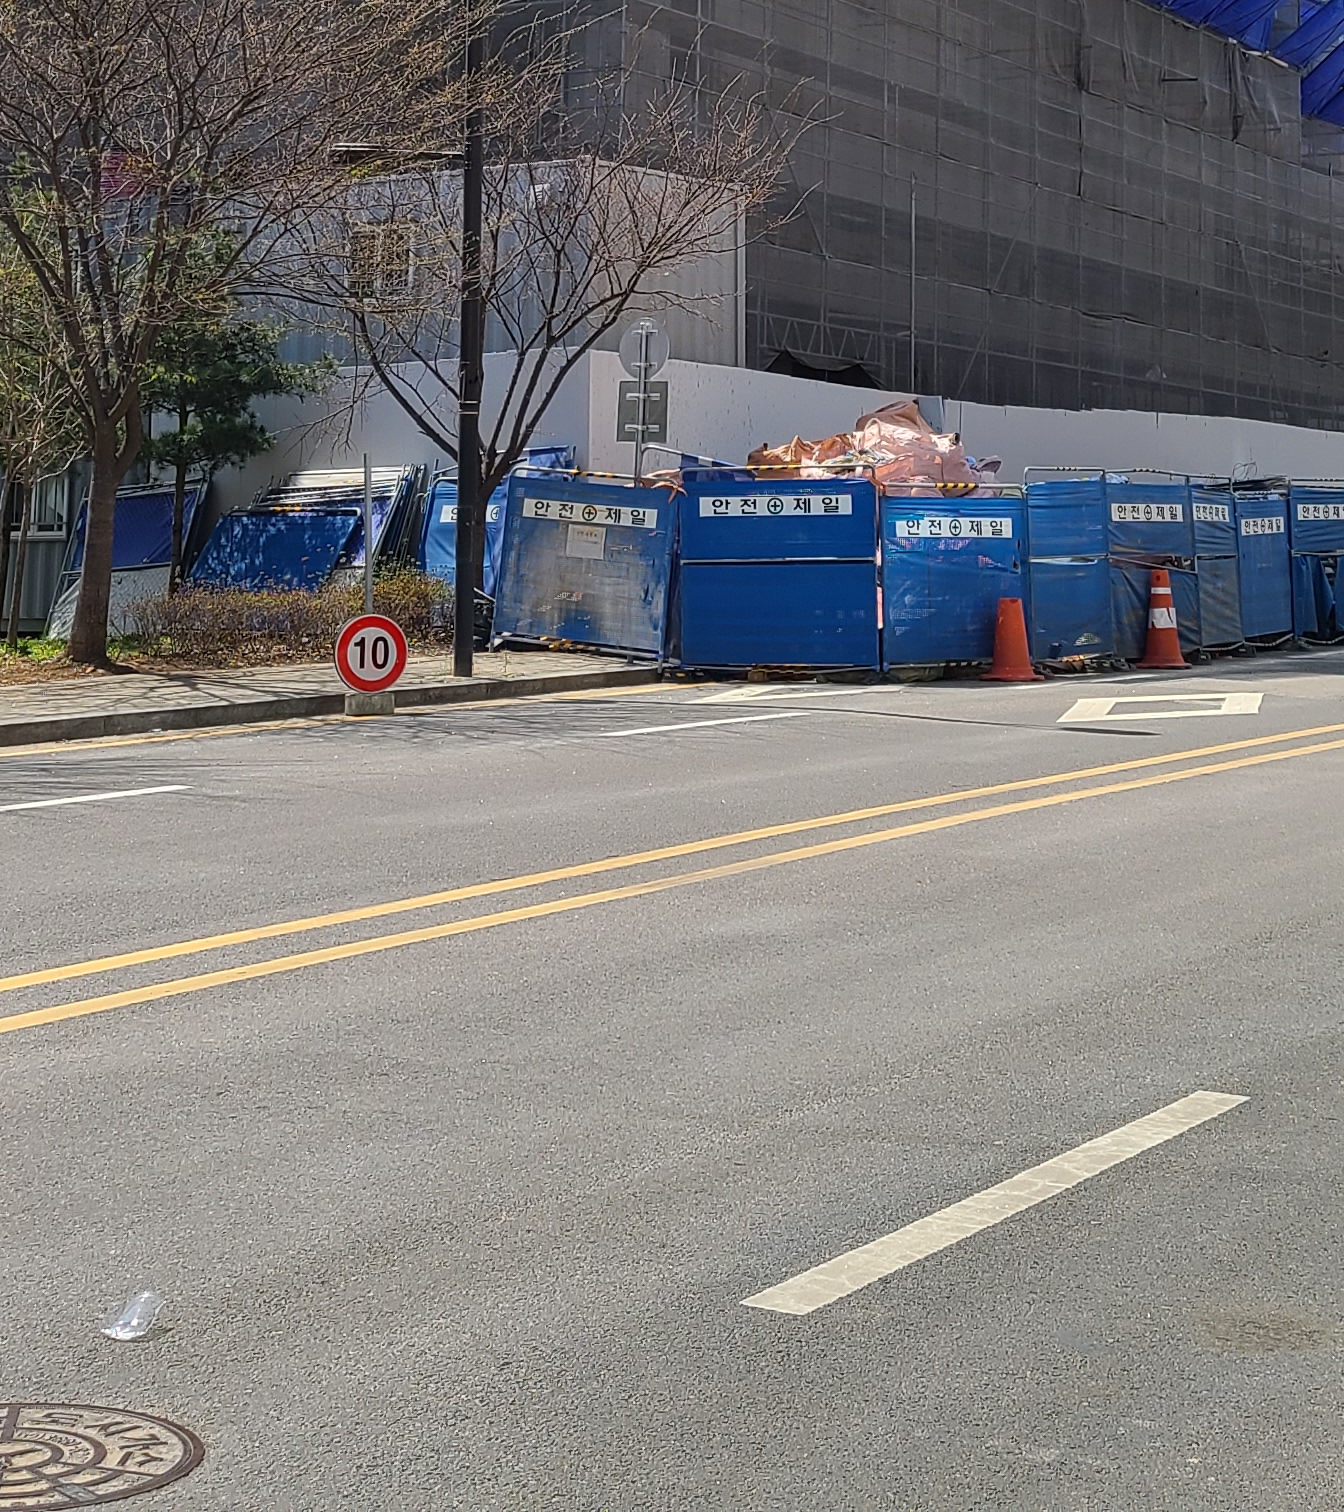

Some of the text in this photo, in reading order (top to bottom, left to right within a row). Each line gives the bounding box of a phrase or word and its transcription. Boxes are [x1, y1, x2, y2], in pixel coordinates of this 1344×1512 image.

[534, 501, 646, 525] 안전 제일
[712, 497, 839, 514] 안전 제일
[1117, 505, 1177, 519] 안전 제일
[906, 519, 1003, 536] 안전 제일
[354, 636, 389, 669] 10
[25, 1412, 168, 1467] 도시가스
